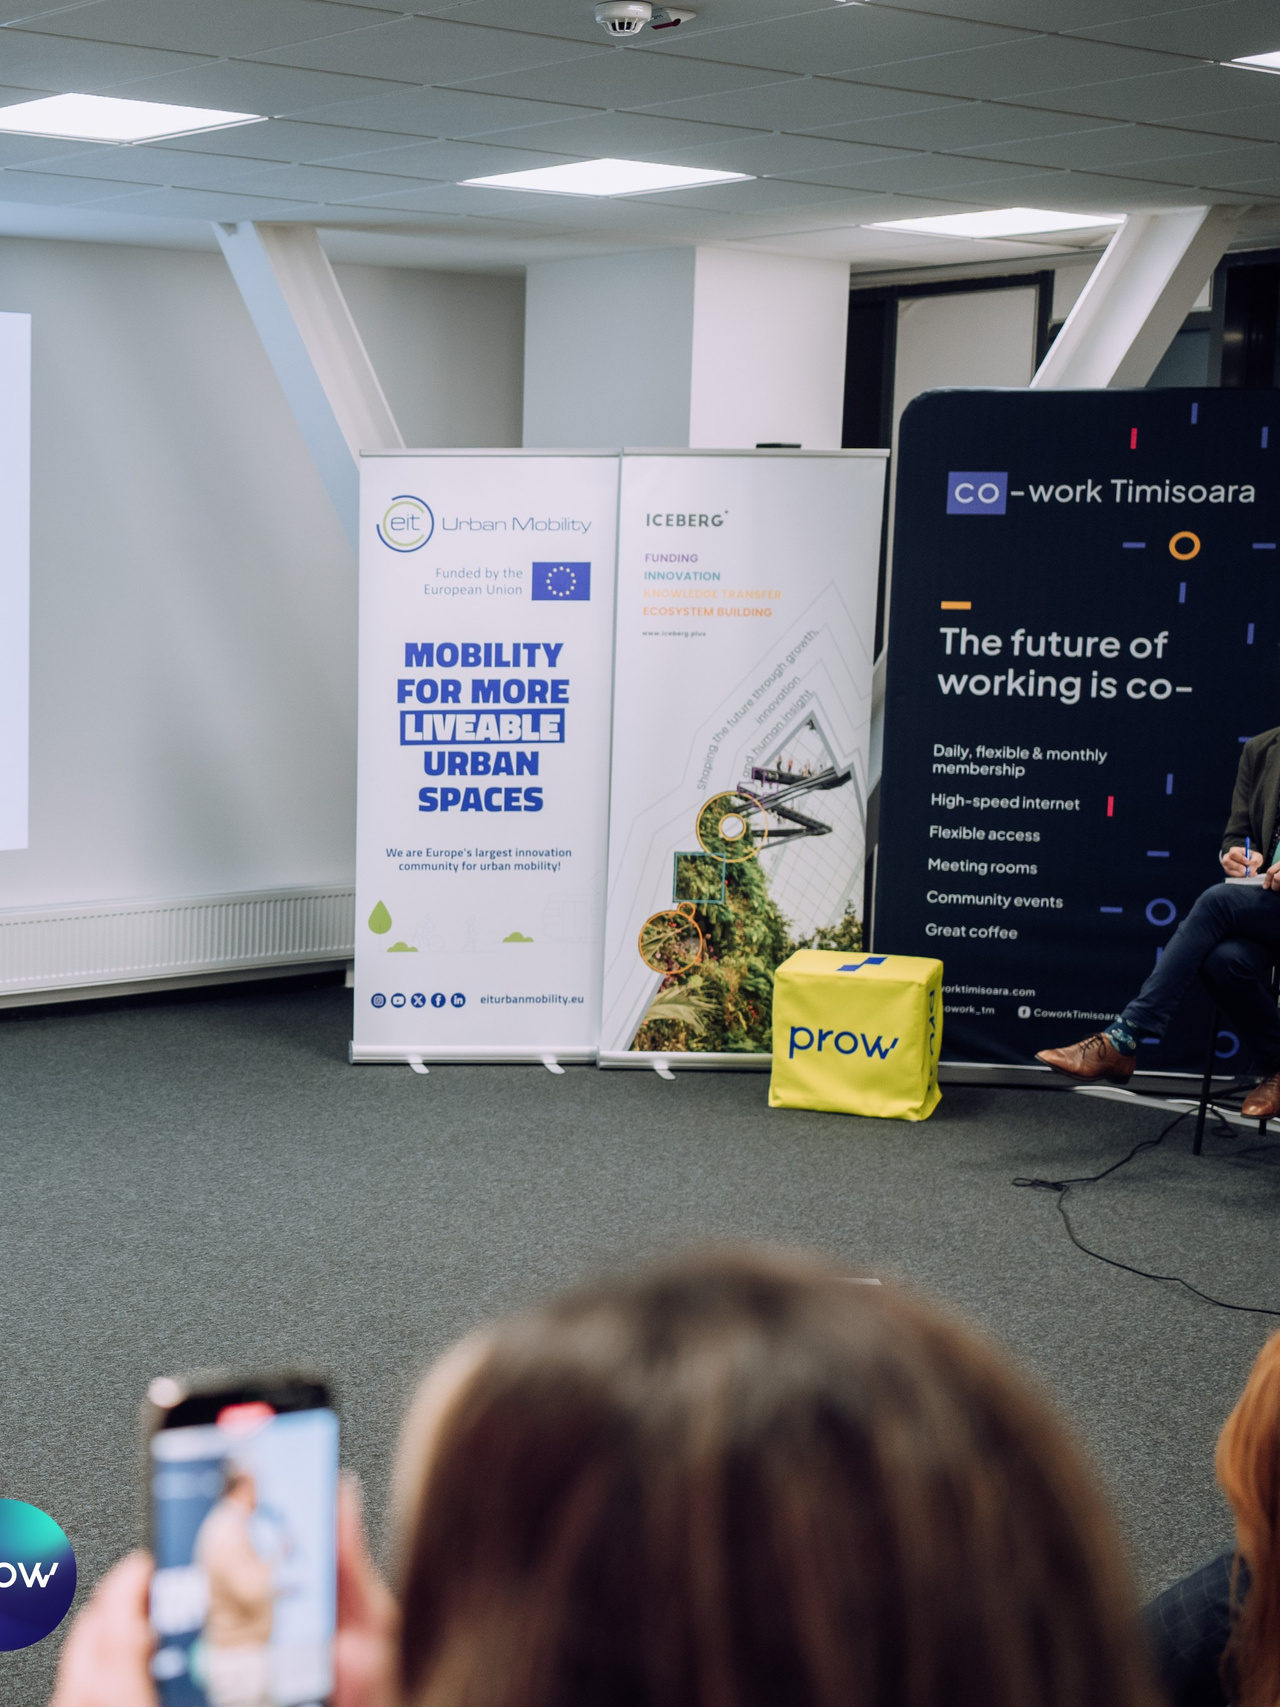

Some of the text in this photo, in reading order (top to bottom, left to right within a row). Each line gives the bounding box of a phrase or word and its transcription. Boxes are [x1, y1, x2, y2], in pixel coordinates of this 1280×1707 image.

[1111, 479, 1256, 503] Timisoara
[390, 514, 420, 531] eit
[442, 516, 592, 534] Urban Mobility
[645, 553, 699, 563] FUNDING
[435, 567, 523, 582] Funded by the
[644, 571, 721, 581] INNOVATION
[424, 584, 523, 598] European Union
[643, 589, 782, 600] KNOWLEDGE TRANSFER
[643, 606, 773, 618] ECOSYSTEM BUILDING
[939, 627, 1169, 659] The future of
[405, 642, 564, 668] MOBILITY
[397, 679, 570, 704] FOR MORE
[937, 668, 1081, 705] working
[1091, 671, 1117, 698] is
[755, 675, 801, 726] innovation
[404, 713, 561, 741] LIVEABLE
[697, 743, 720, 791] Shaping
[712, 727, 730, 744] the
[726, 698, 755, 728] future
[751, 661, 788, 700] through
[742, 754, 755, 778] and
[752, 721, 785, 757] human
[933, 743, 1108, 765] Daily, flexible & monthly
[424, 751, 539, 776] URBAN
[932, 762, 1026, 779] membership
[418, 787, 544, 812] SPACES
[931, 793, 1080, 811] High-speed internet
[929, 825, 1041, 842] Flexible access
[386, 848, 404, 857] We
[426, 848, 472, 859] Europe's
[475, 848, 512, 859] largest
[515, 848, 572, 857] innovation
[399, 861, 561, 872] community for urban mobility!
[928, 857, 1038, 876] Meeting rooms
[926, 890, 1064, 909] Community events
[925, 923, 1018, 939] Great coffee
[480, 994, 584, 1005] eiturbanmobility.eu
[789, 1026, 899, 1059] prow
